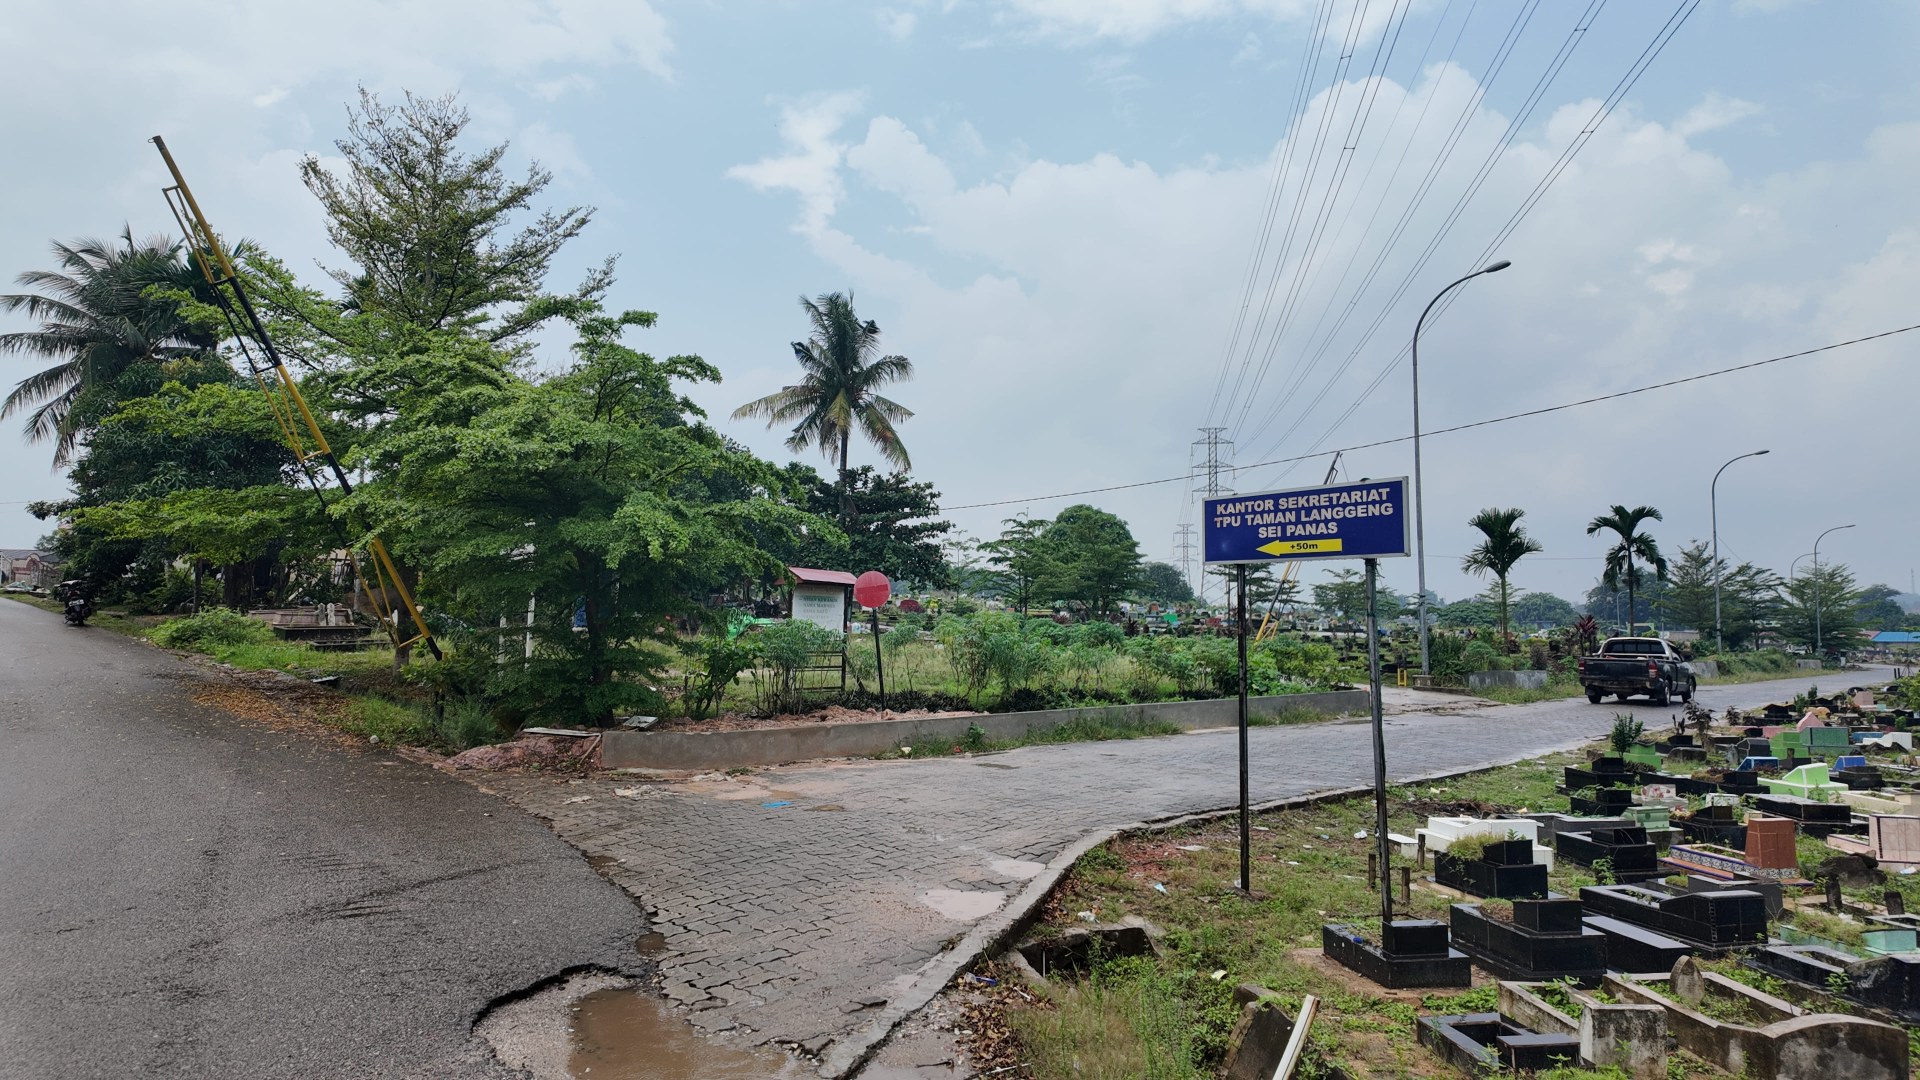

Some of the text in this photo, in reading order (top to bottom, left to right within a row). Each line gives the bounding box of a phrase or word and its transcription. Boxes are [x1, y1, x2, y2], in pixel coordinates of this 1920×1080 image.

[1216, 488, 1390, 515] KANTOR SEKRETARIAT
[1214, 503, 1394, 528] TPU TAMAN LANGGENG
[1258, 522, 1338, 539] SEI PANAS
